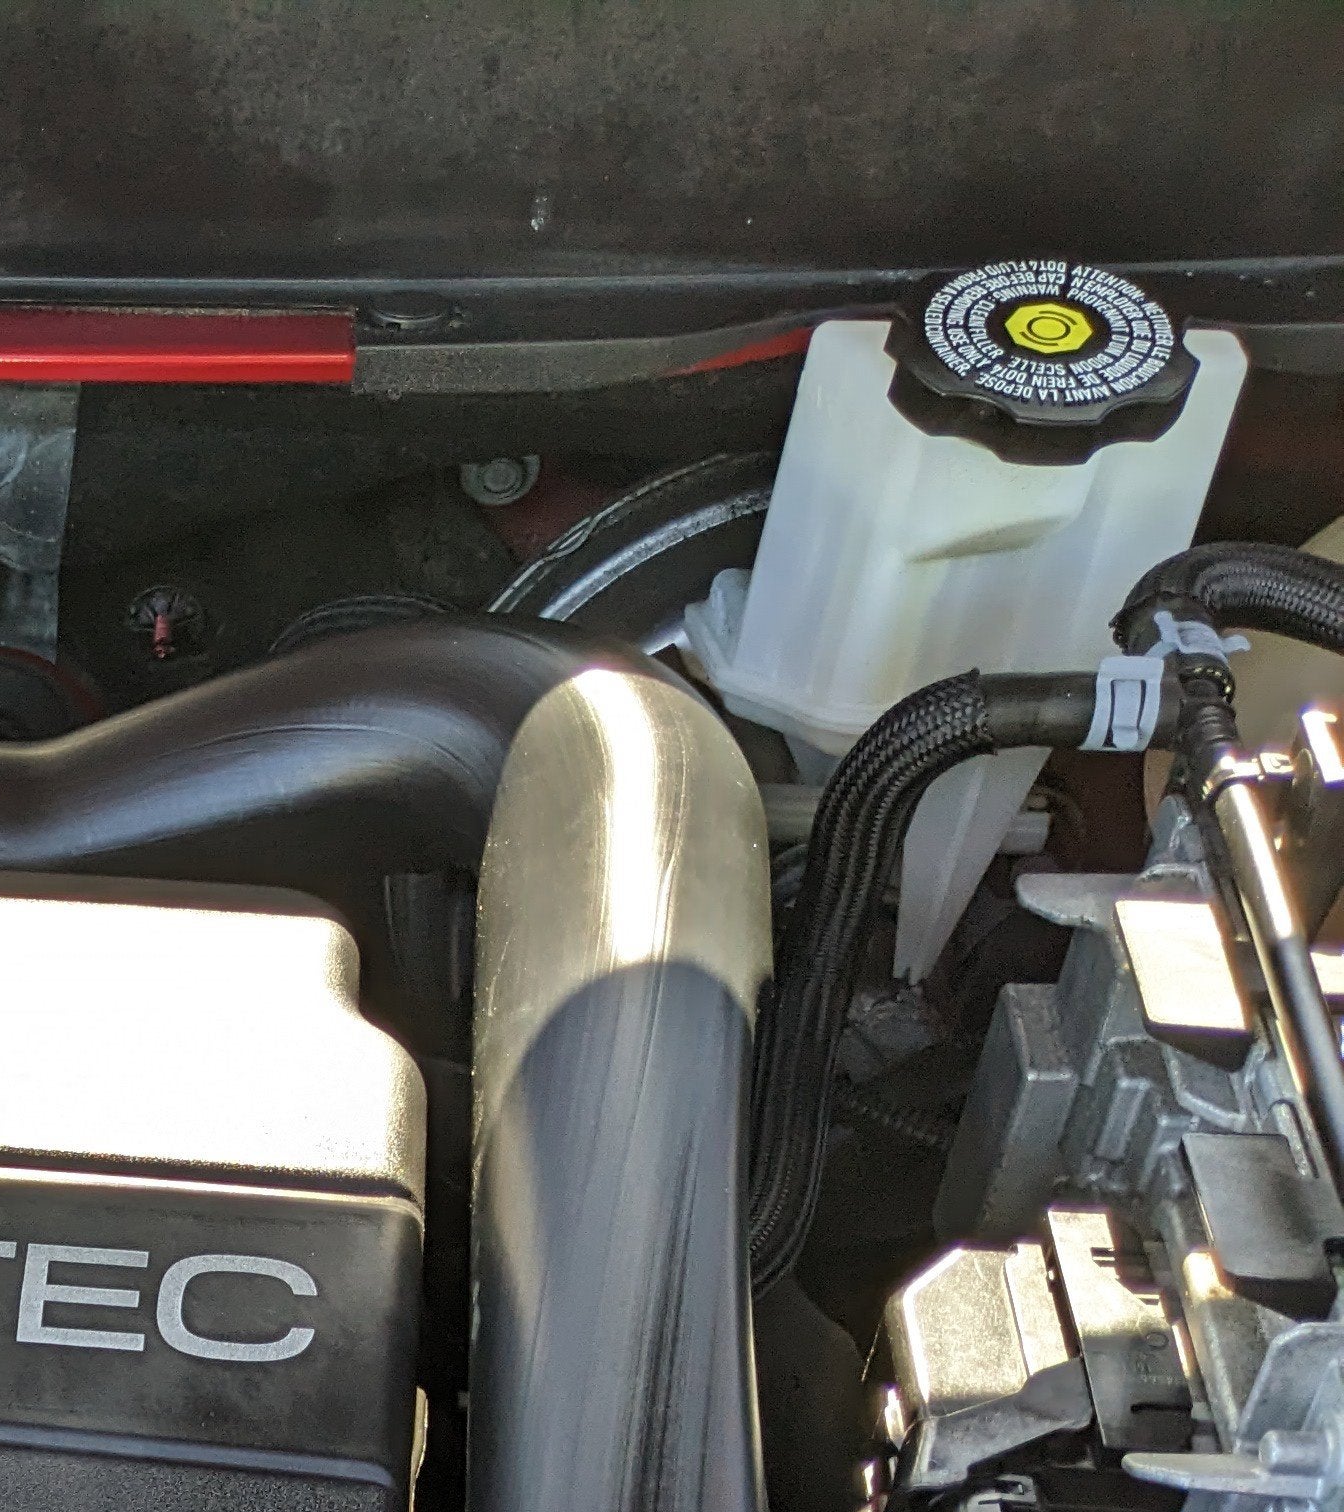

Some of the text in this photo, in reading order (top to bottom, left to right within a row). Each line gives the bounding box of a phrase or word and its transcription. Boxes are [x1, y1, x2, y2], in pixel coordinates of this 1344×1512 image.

[985, 261, 1027, 275] FLUID
[981, 271, 1035, 291] BEFORE
[1038, 273, 1066, 284] CAP
[958, 345, 992, 368] ONLY
[1031, 375, 1076, 388] FREIN
[1078, 373, 1102, 387] DE
[1038, 388, 1058, 402] LA
[1064, 385, 1111, 402] AVANT
